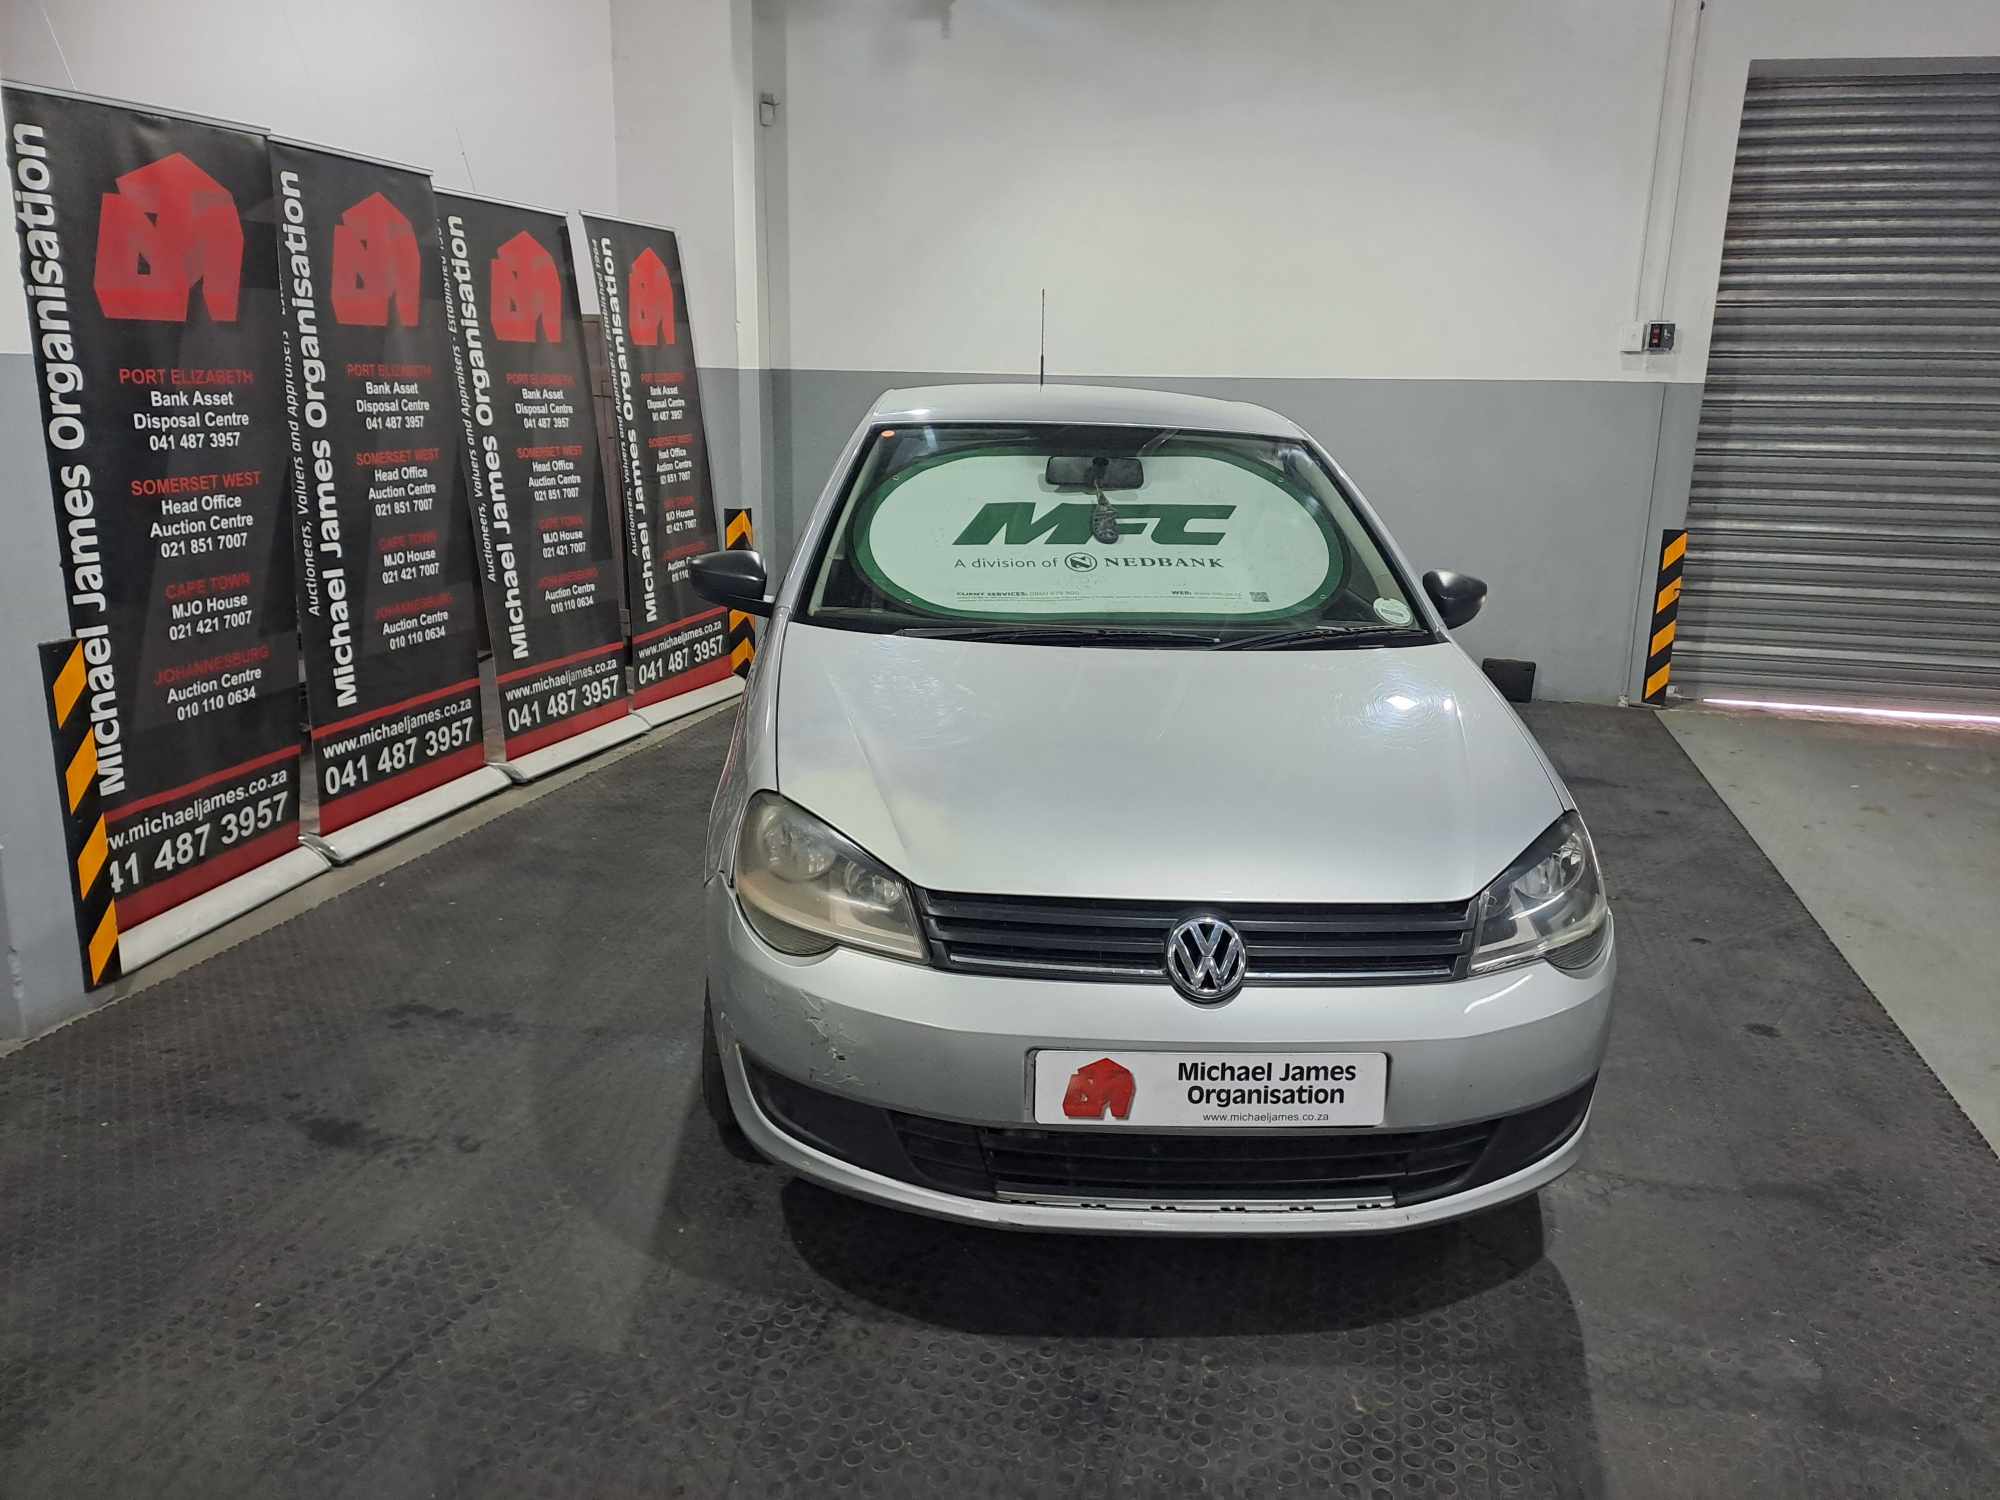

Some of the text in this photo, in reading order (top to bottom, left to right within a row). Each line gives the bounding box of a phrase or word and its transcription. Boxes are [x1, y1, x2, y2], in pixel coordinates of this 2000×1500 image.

[119, 368, 254, 385] PORT ELIZABETH
[365, 381, 419, 395] Bank Asset
[452, 345, 470, 417] Appraisers
[150, 390, 234, 407] Bank Asset
[356, 398, 430, 415] Disposal Centre
[521, 388, 565, 399] Bank Asset
[133, 411, 249, 432] Disposal Centre
[514, 402, 548, 416] Disposal
[365, 415, 424, 430] 041 487 3957
[462, 419, 476, 445] and
[601, 237, 657, 623] Michael James Organisation
[149, 431, 241, 451] 041 487 3957
[280, 170, 358, 708] Michael James Organisation
[287, 420, 302, 452] and
[448, 215, 529, 660] Michael James Organisation
[13, 122, 125, 797] Michael James Organisation
[532, 460, 574, 472] Head Office
[131, 471, 262, 496] SOMERSET WEST
[291, 457, 309, 515] Valuers
[374, 466, 428, 482] Head Office
[467, 449, 483, 498] Valuers
[528, 476, 556, 488] Auction
[368, 482, 436, 500] Auction Centre
[161, 495, 242, 516] Head Office
[375, 498, 433, 517] 021 851 7007
[150, 512, 254, 539] Auction Centre
[560, 530, 583, 541] House
[951, 501, 1238, 546] MFC
[160, 531, 248, 559] 021 851 7007
[478, 503, 496, 582] Auctioneers,
[300, 520, 320, 616] Auctioneers,
[383, 549, 436, 567] MJO House
[953, 556, 1226, 571] A division of NEDBANK
[166, 572, 251, 599] CAPE TOWN
[382, 562, 440, 585] 021 421 7007
[172, 594, 248, 620] MJO House
[545, 588, 571, 601] Auction
[169, 610, 253, 641] 021 421 7007
[382, 609, 449, 636] Auction Centre
[389, 625, 445, 651] 010 110 0634
[638, 619, 722, 658] www.michaeljames.co.za
[638, 634, 723, 685] 041 487 3957
[167, 667, 263, 704] Auction Centre
[505, 658, 617, 702] www.michaeljames.co.za
[177, 685, 256, 721] 010 110 0634
[507, 674, 619, 732] 041 487 3957
[322, 698, 472, 760] www.michaeljames.co.za
[324, 717, 474, 796] 041 487 3957
[153, 823, 211, 874] 487
[221, 790, 289, 847] 3957
[1177, 1061, 1357, 1082] Michael James
[1186, 1084, 1345, 1107] Organisation
[1202, 1112, 1329, 1123] www.michaeljames.co.za
